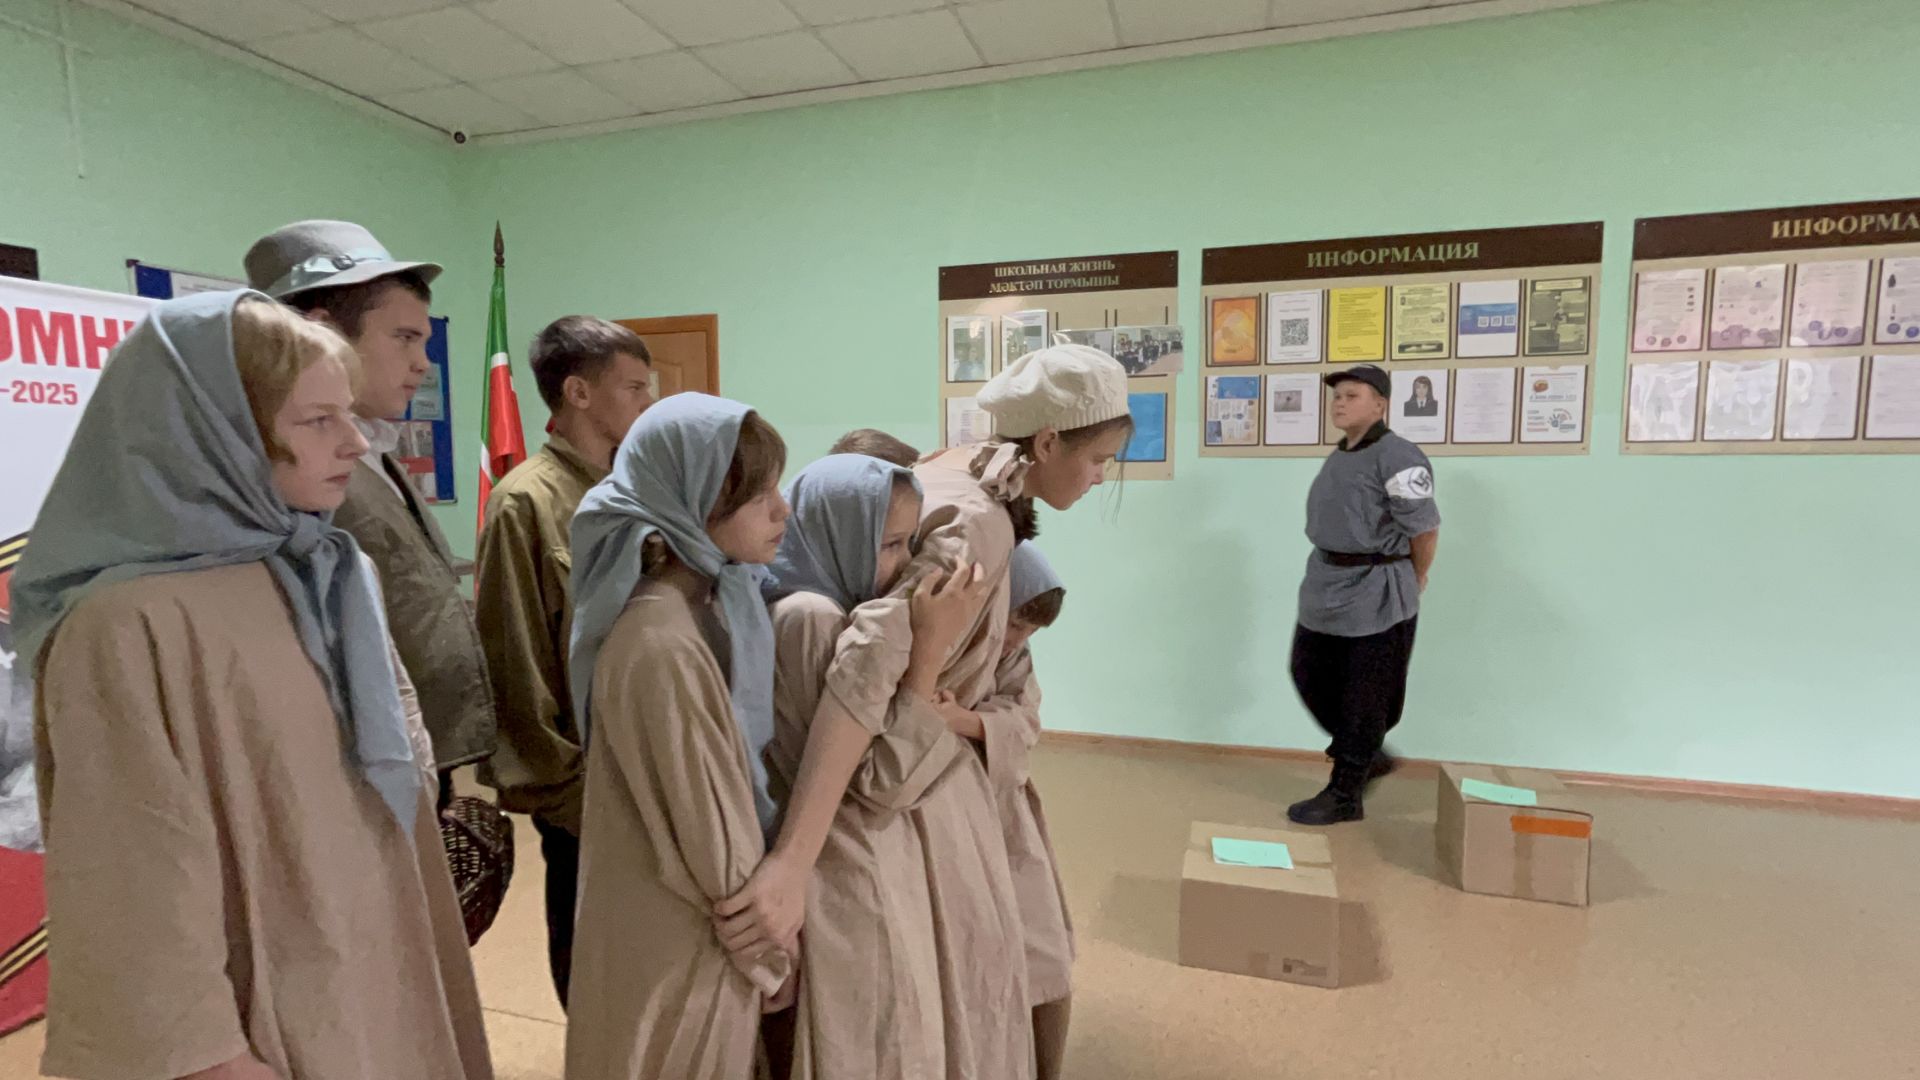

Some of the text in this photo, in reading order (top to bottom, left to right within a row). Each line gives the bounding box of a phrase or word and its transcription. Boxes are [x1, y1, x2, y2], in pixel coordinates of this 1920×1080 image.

[1771, 212, 1920, 239] ИНФОРМА
[1307, 242, 1480, 268] ИНФОРМАЦИЯ
[995, 260, 1116, 278] ШКОЛЬНАЯ ЖИЗНЬ
[1045, 275, 1120, 290] ТОРМЫШЫ
